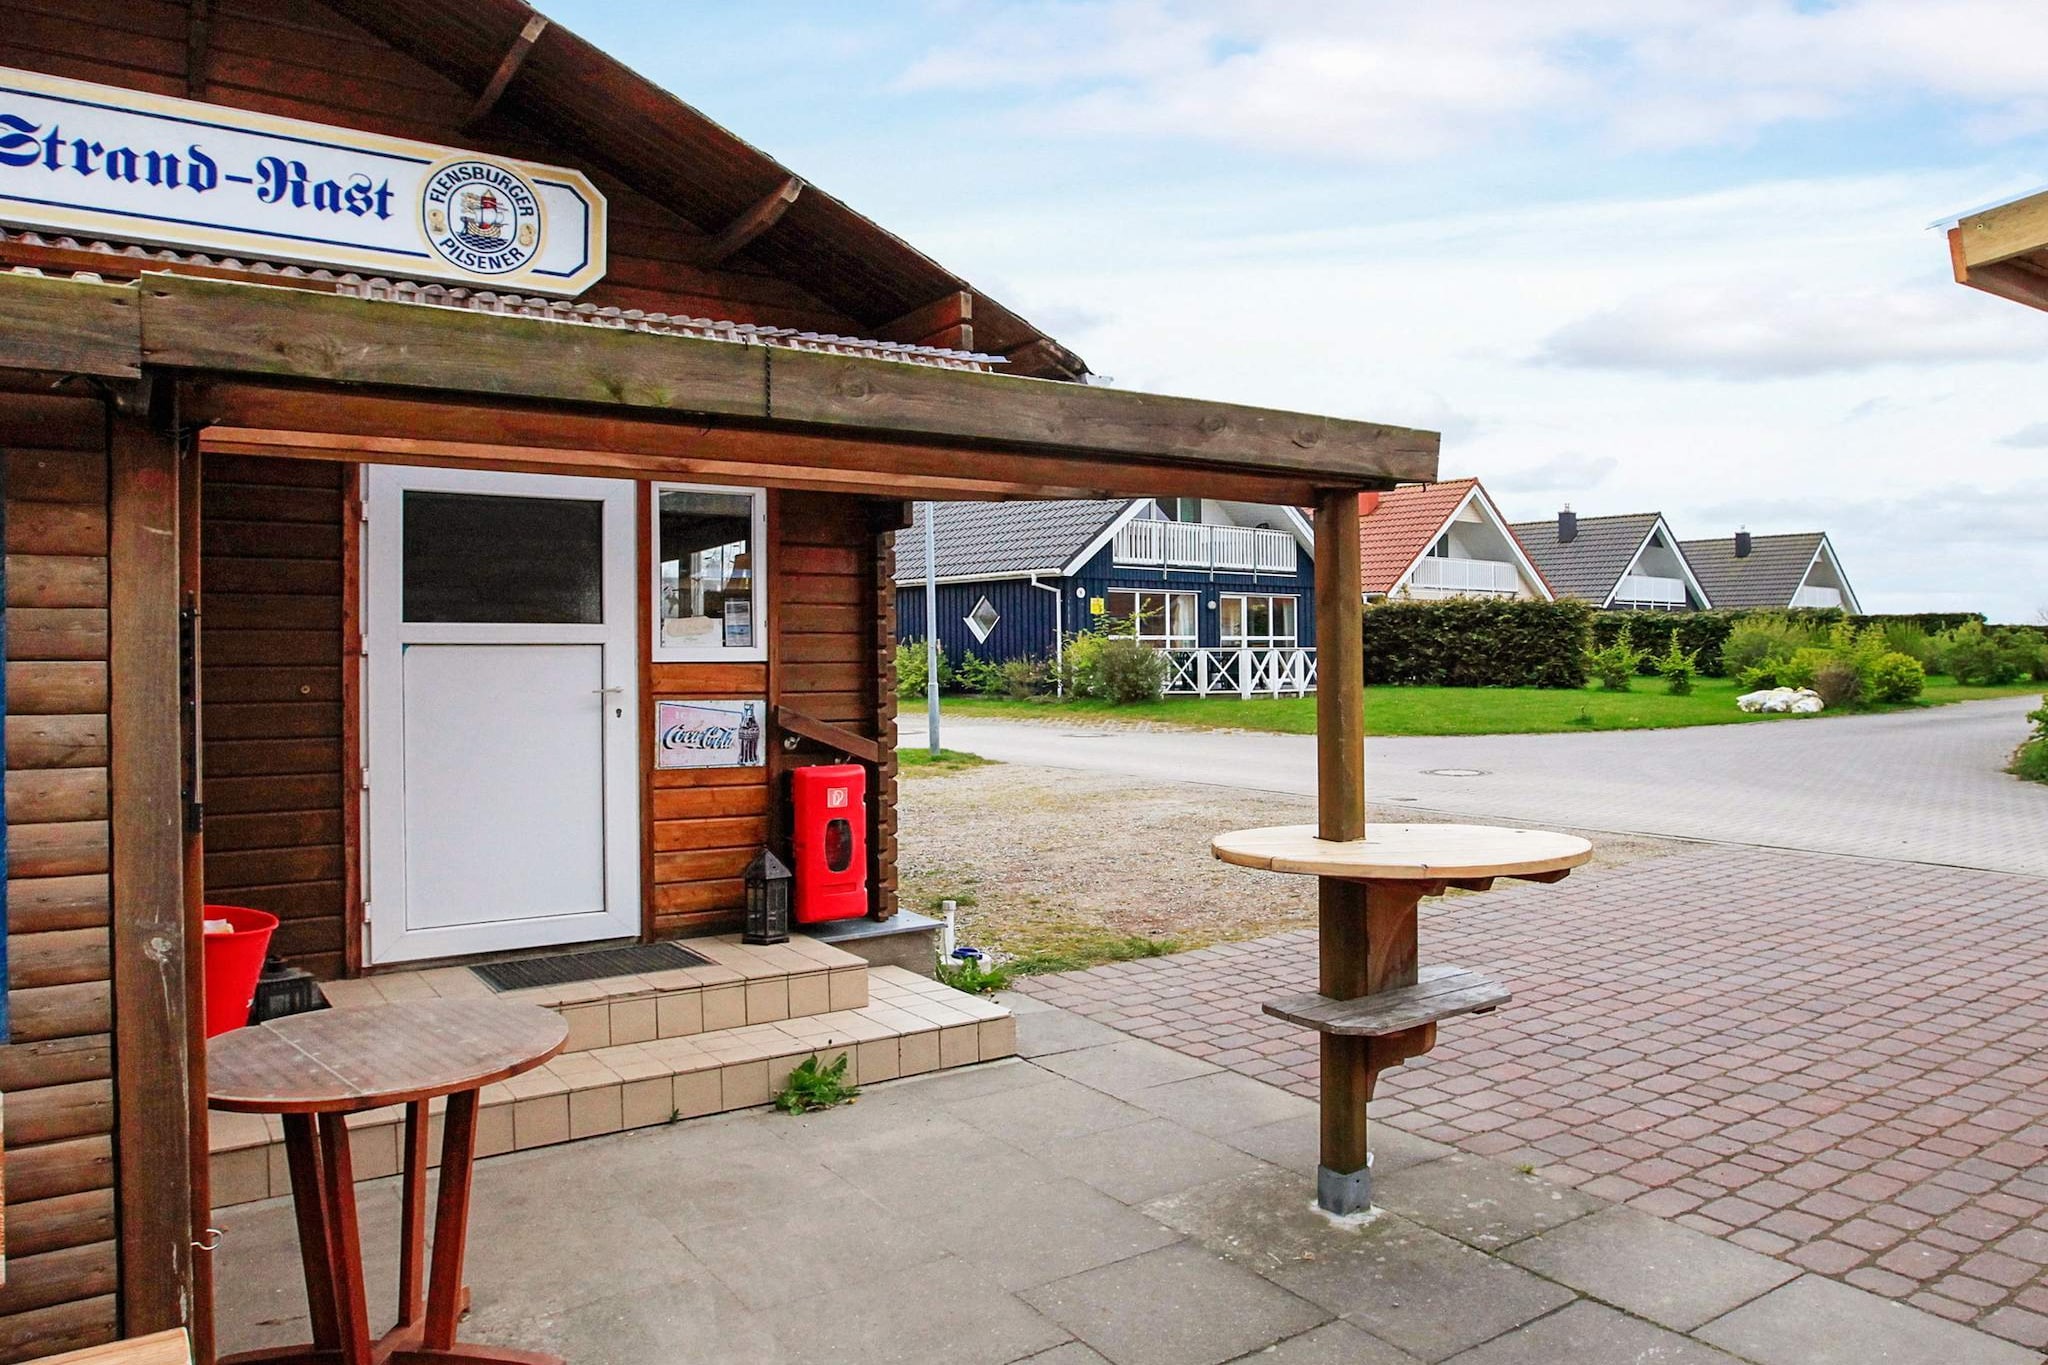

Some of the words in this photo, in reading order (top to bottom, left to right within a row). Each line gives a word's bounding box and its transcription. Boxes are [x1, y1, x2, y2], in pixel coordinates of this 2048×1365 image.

[0, 113, 394, 221] Strand-Rast
[429, 166, 534, 217] FLENSBURGER
[439, 238, 525, 270] PILSENER
